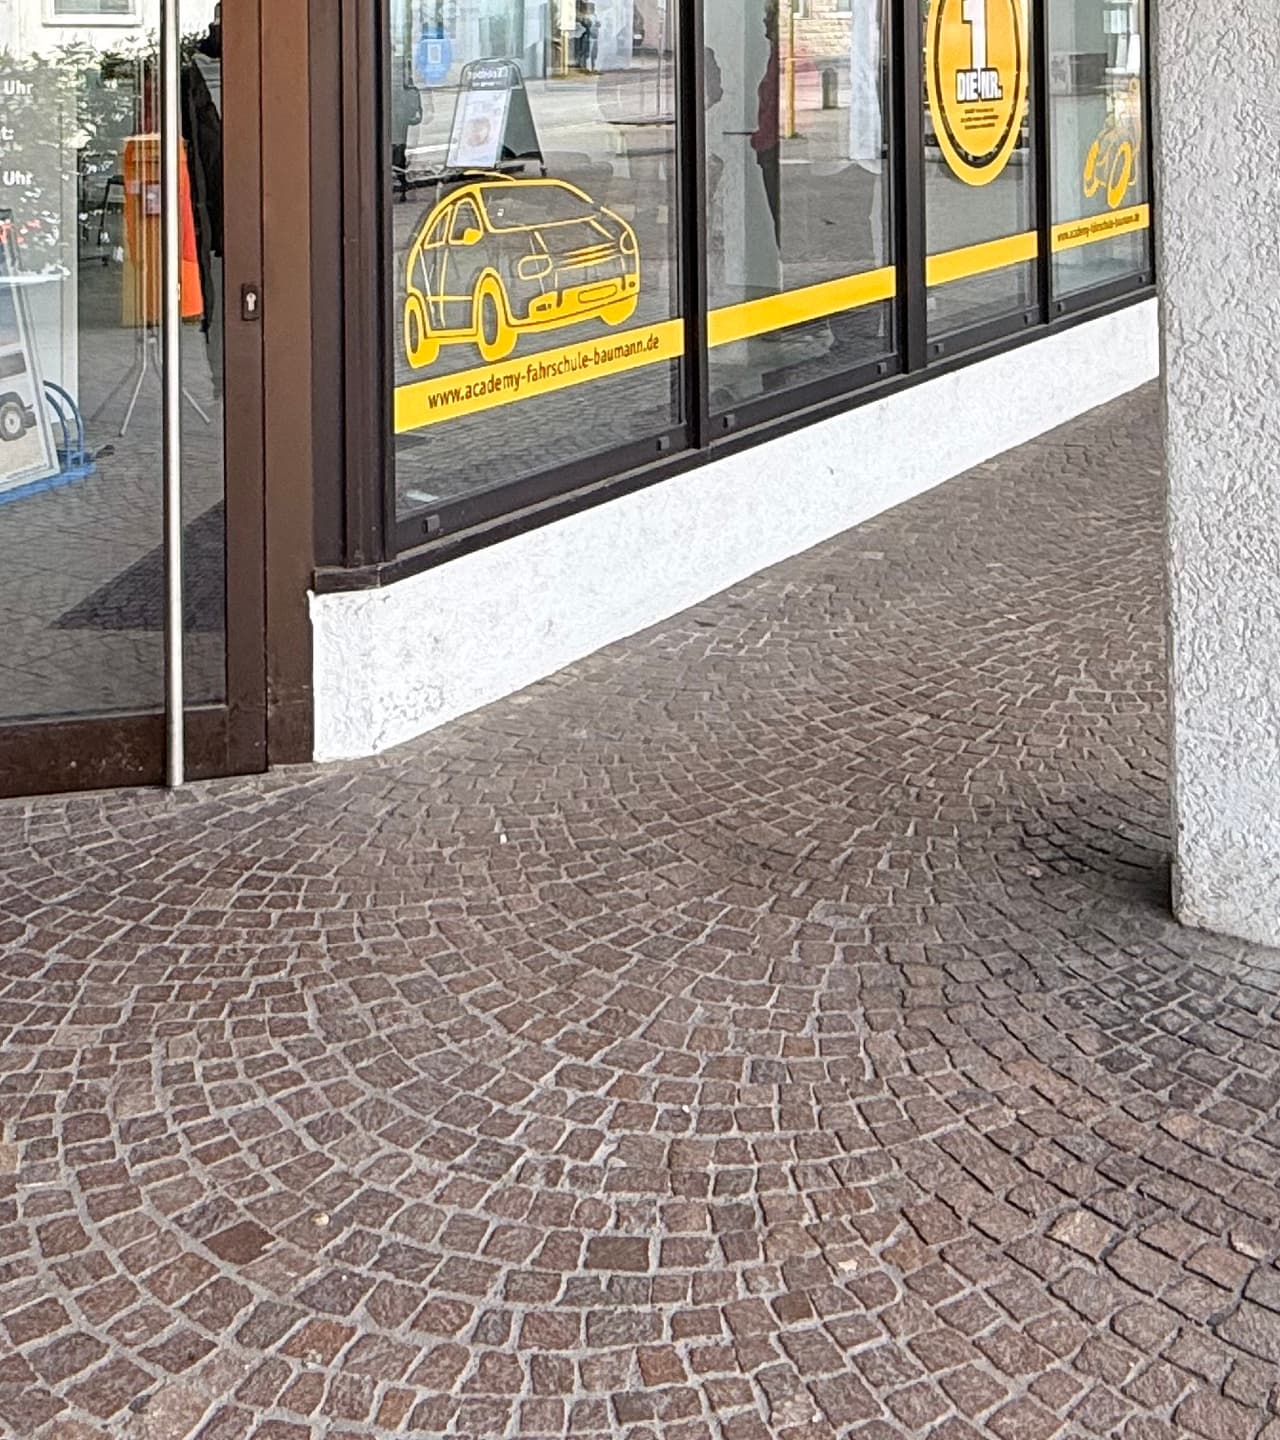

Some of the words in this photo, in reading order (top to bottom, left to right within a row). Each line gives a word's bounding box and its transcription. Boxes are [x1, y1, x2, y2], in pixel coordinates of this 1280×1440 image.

[3, 80, 34, 95] Uhr
[956, 69, 979, 103] DIE
[3, 171, 34, 186] Uhr
[428, 333, 660, 409] www.academy-fahrschule-baumann.de
